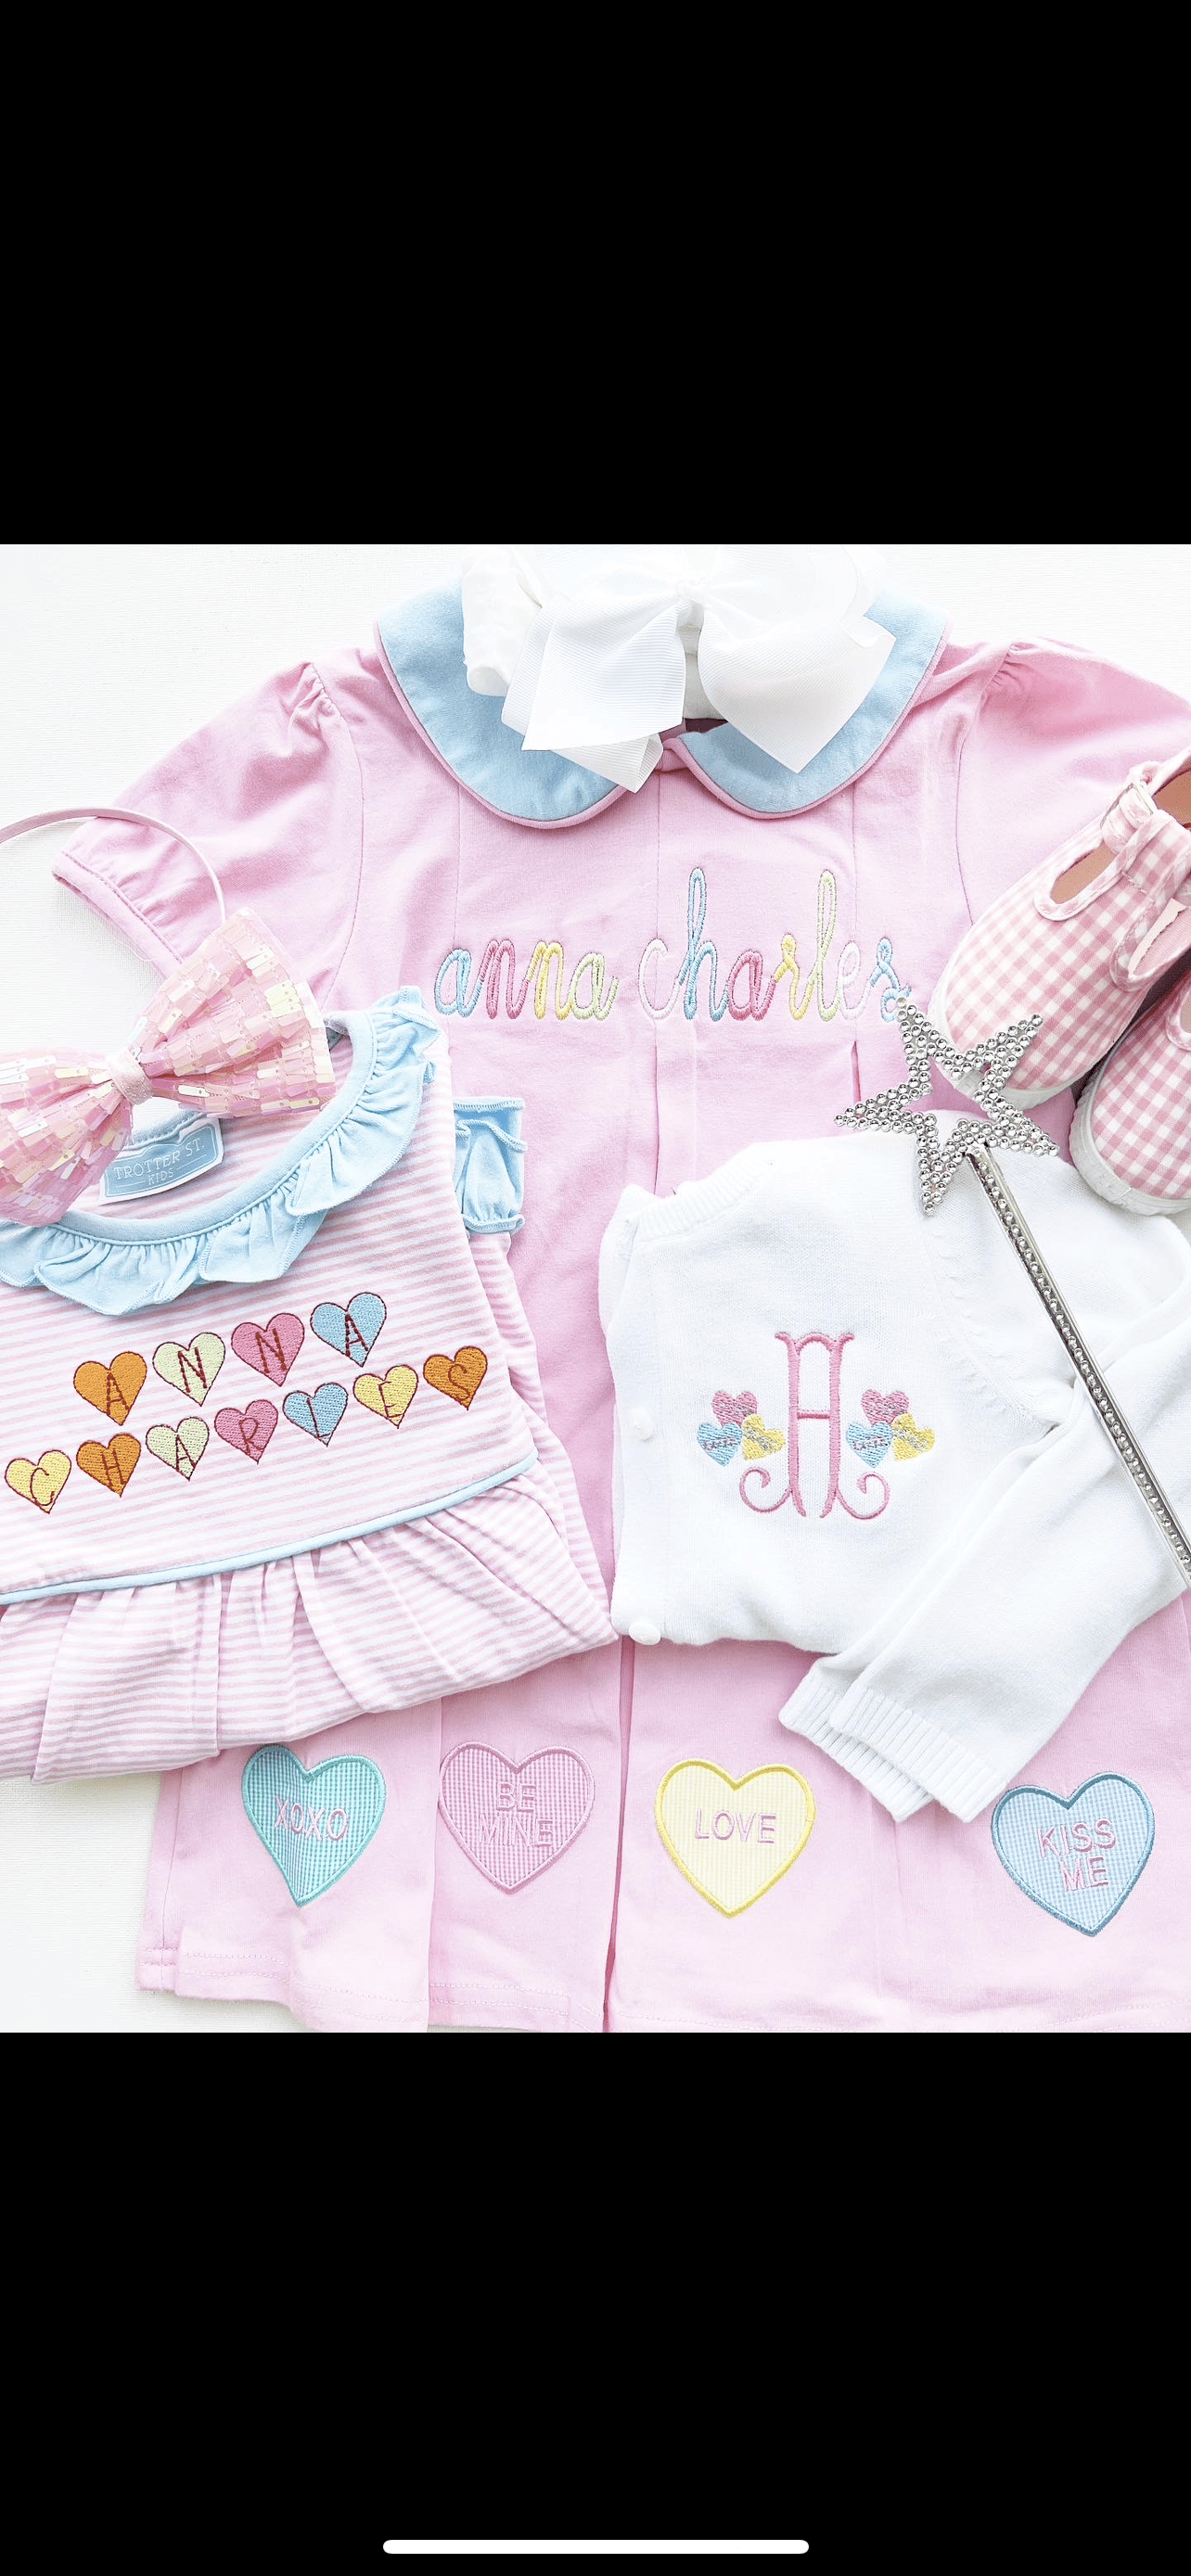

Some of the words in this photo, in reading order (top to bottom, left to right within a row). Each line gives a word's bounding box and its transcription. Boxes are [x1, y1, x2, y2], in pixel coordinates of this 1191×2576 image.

[434, 939, 619, 1020] anna
[637, 867, 912, 1023] charles
[113, 1150, 181, 1181] TROTTER
[186, 1137, 205, 1157] ST.
[147, 1167, 174, 1186] KIDS
[105, 1313, 369, 1417] ANNA
[29, 1361, 470, 1507] CHARLES
[495, 1781, 537, 1813] BE
[273, 1796, 348, 1842] XOXO
[478, 1812, 554, 1848] MINE
[695, 1808, 777, 1844] LOVE
[1034, 1817, 1117, 1859] KISS
[1058, 1855, 1109, 1893] ME
